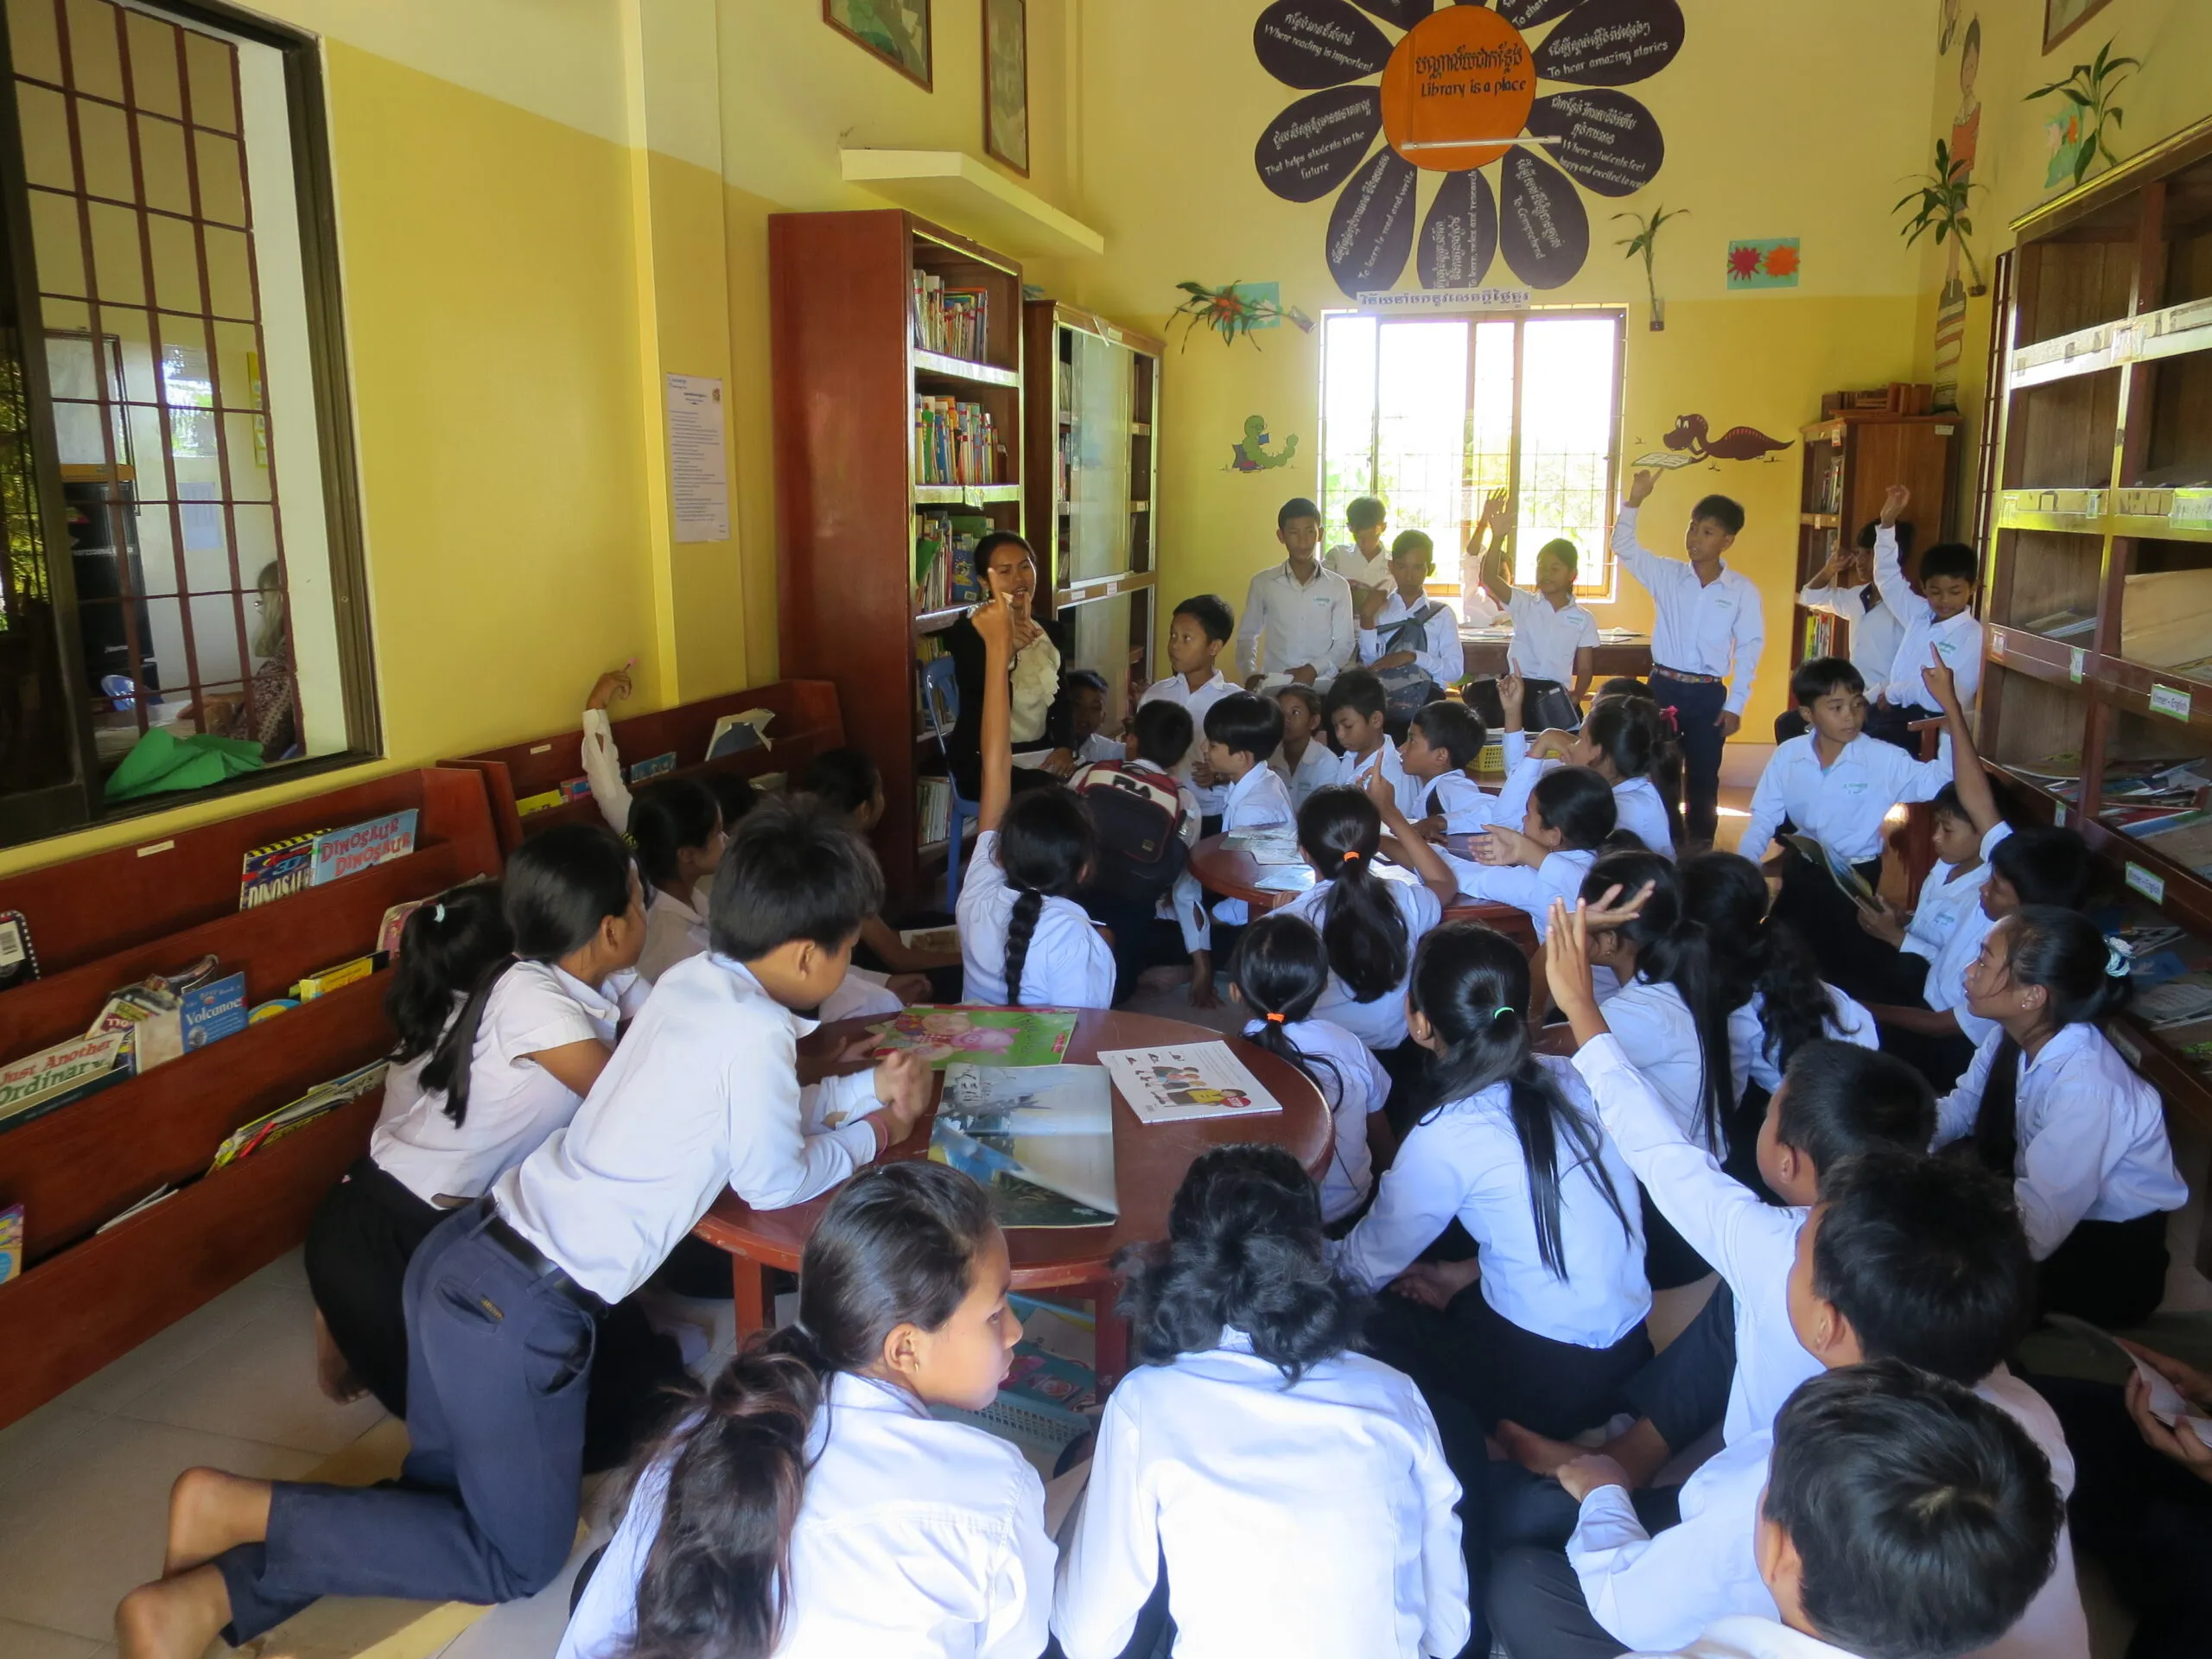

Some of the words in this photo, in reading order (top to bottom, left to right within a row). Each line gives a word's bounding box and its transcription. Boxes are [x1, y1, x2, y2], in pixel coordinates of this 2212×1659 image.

[1512, 14, 1526, 28] To
[1264, 23, 1292, 42] Where
[1292, 37, 1323, 57] reading
[1324, 47, 1332, 57] is
[1332, 48, 1374, 72] important
[1547, 66, 1560, 79] To
[1563, 60, 1585, 76] hear
[1589, 50, 1631, 69] amazing
[1633, 41, 1669, 58] stories
[1420, 81, 1465, 98] Library
[1470, 79, 1481, 94] is
[1483, 81, 1491, 92] a
[1494, 77, 1527, 97] place
[1265, 162, 1283, 176] That
[1285, 155, 1306, 168] helps
[1307, 140, 1342, 160] students
[1342, 137, 1351, 146] in
[1351, 131, 1365, 143] the
[1300, 162, 1330, 180] future
[1559, 156, 1579, 173] happy
[1579, 165, 1593, 174] and
[1592, 169, 1622, 183] excited
[1621, 175, 1630, 187] to
[1562, 139, 1590, 156] Where
[1592, 150, 1628, 168] students
[1628, 159, 1646, 172] feel
[1468, 171, 1478, 208] research
[1513, 194, 1523, 207] To
[1357, 270, 1370, 279] To
[1364, 245, 1381, 267] learn
[1375, 232, 1385, 245] to
[1382, 214, 1393, 235] read
[1391, 195, 1403, 215] and
[1401, 171, 1414, 197] write
[1468, 213, 1477, 227] and
[1517, 207, 1546, 259] Comprehend
[321, 818, 399, 863] DINOSAUR
[334, 832, 412, 877] DINOSAUR
[186, 997, 243, 1026] Volcanoe
[2, 1065, 37, 1085] Just
[43, 1039, 115, 1071] Another
